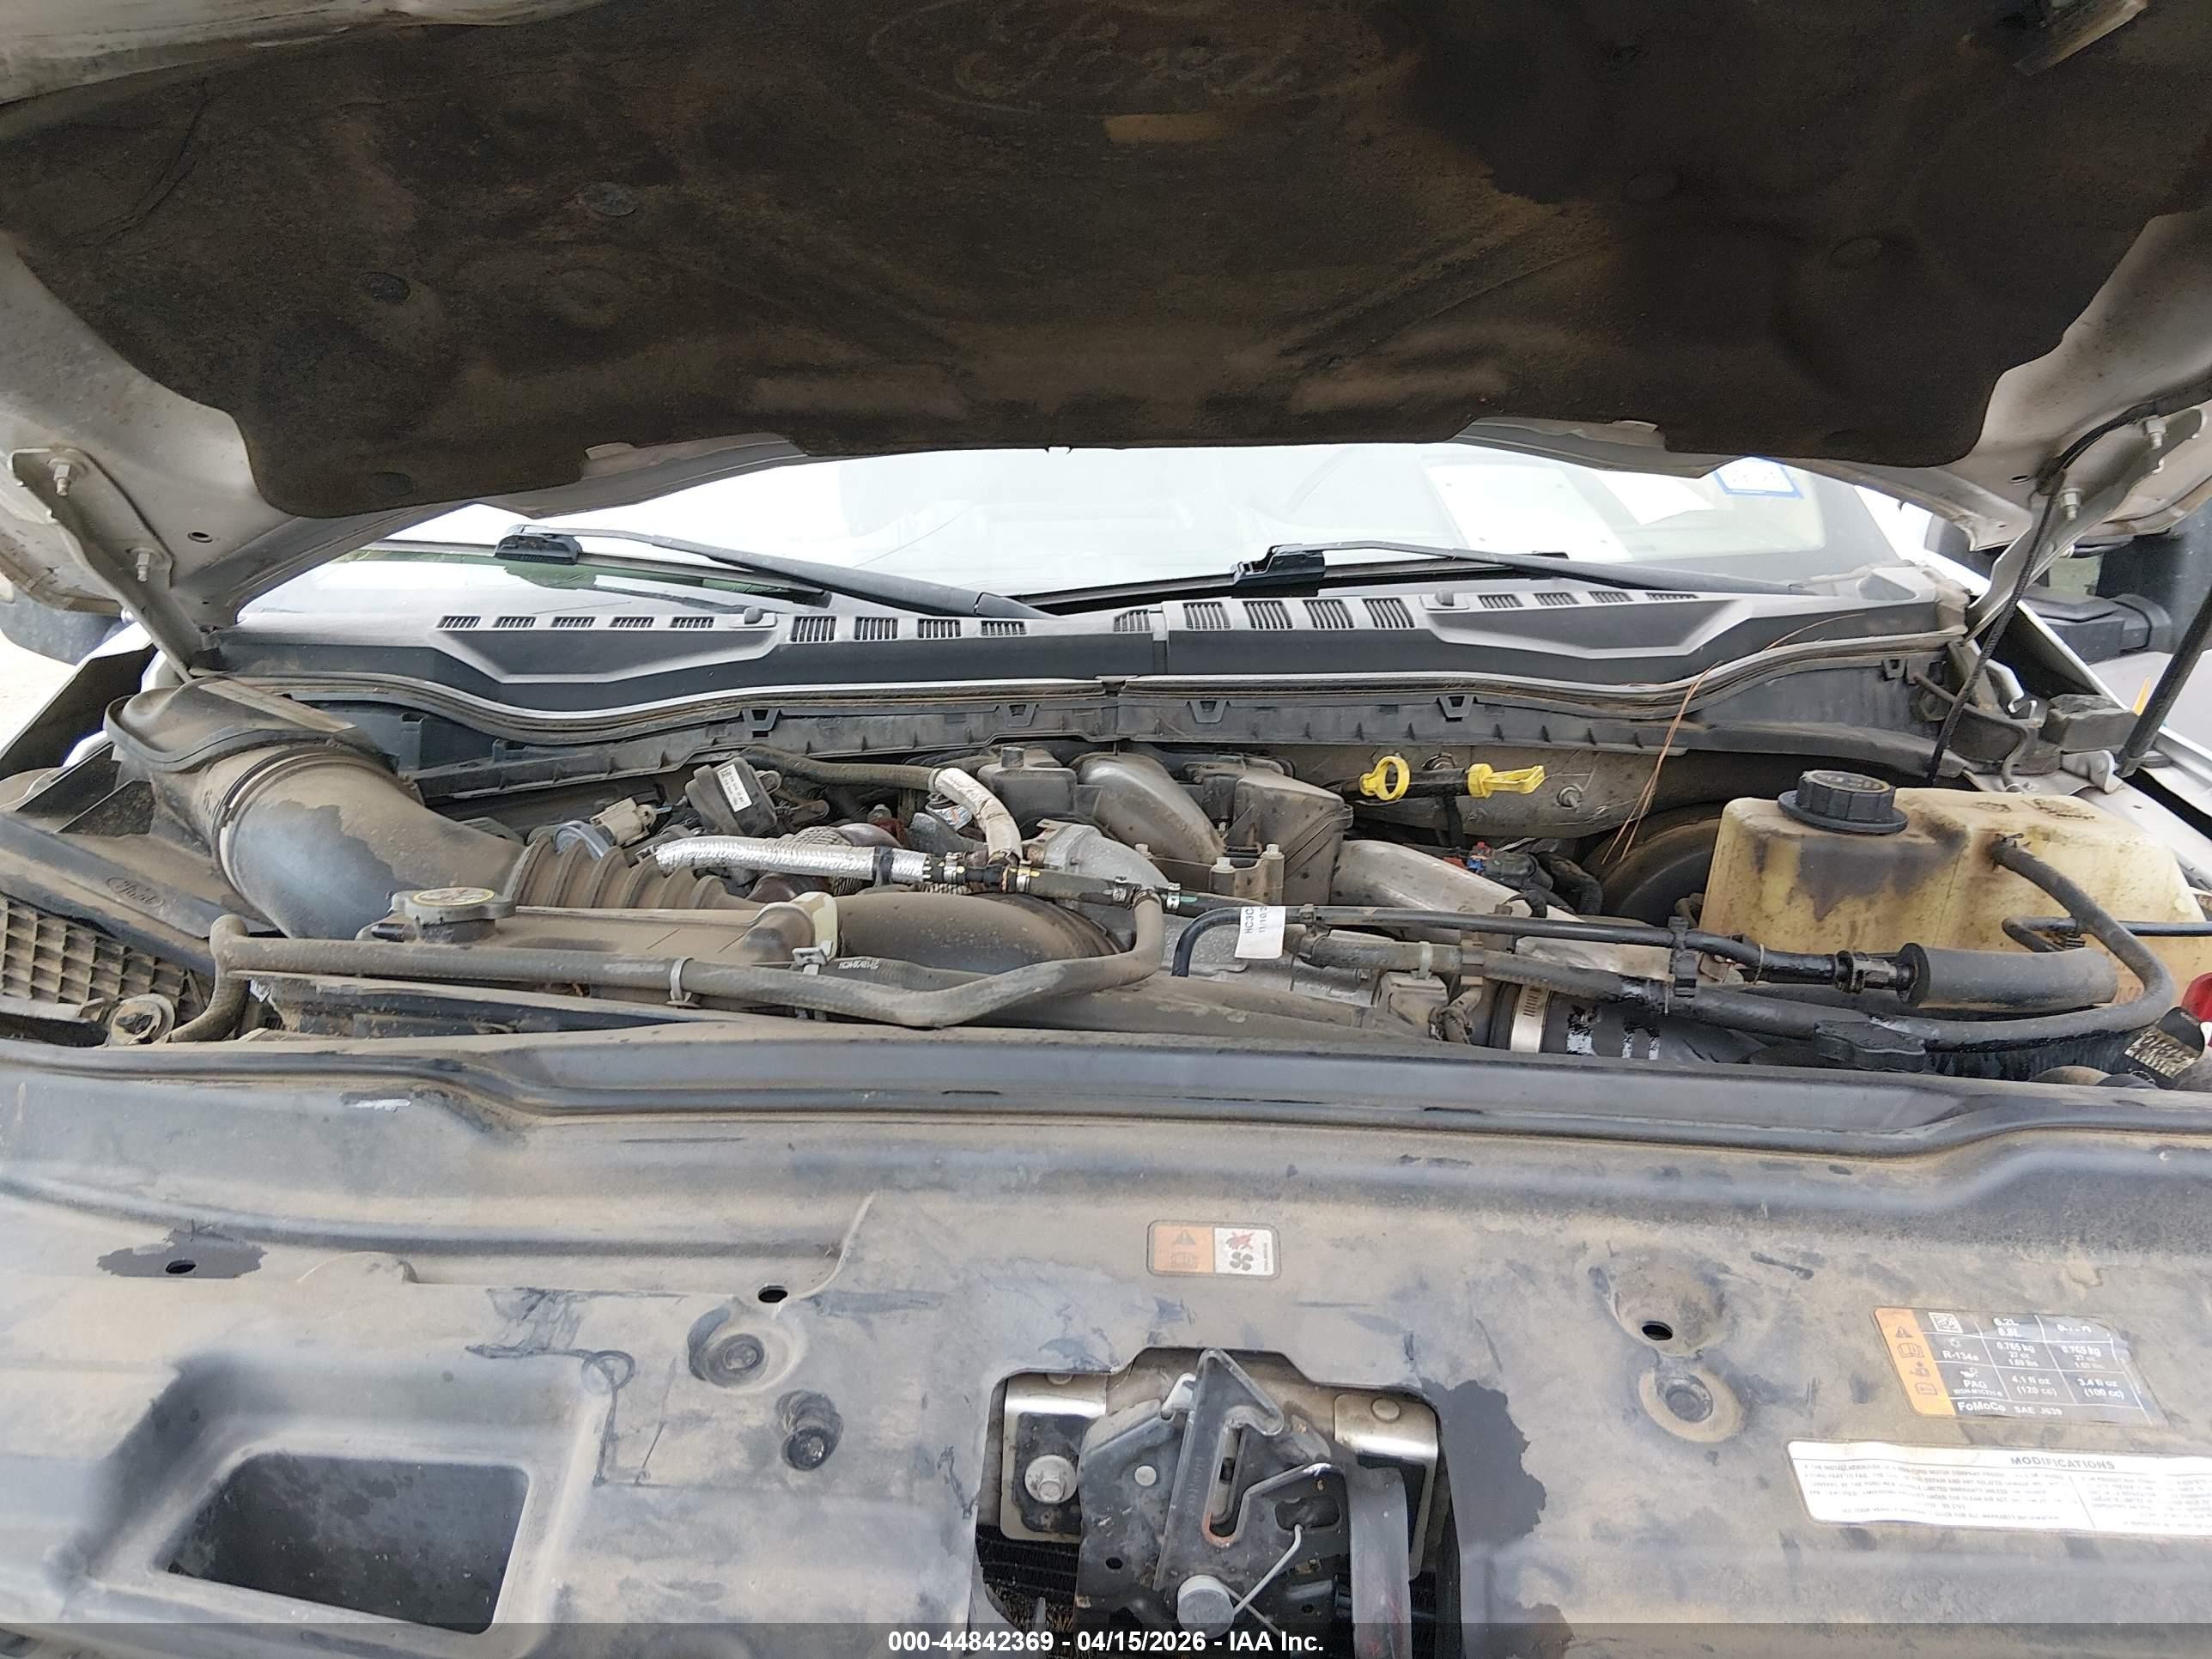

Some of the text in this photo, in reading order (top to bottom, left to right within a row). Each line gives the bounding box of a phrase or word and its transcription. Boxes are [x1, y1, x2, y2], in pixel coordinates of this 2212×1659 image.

[1993, 1317, 2020, 1327] 6.2L
[2022, 1344, 2036, 1354] kg
[2088, 1346, 2101, 1357] kg
[1942, 1350, 1979, 1361] R-134a
[1963, 1379, 1988, 1389] PAG
[2011, 1375, 2027, 1384] 4.1
[2076, 1378, 2094, 1387] 3.4
[2016, 1386, 2039, 1395] (120
[2084, 1389, 2106, 1397] (100
[1957, 1401, 2007, 1412] FoMoCo
[2013, 1406, 2036, 1414] SAE
[2010, 1456, 2116, 1470] MODIFICATIONS
